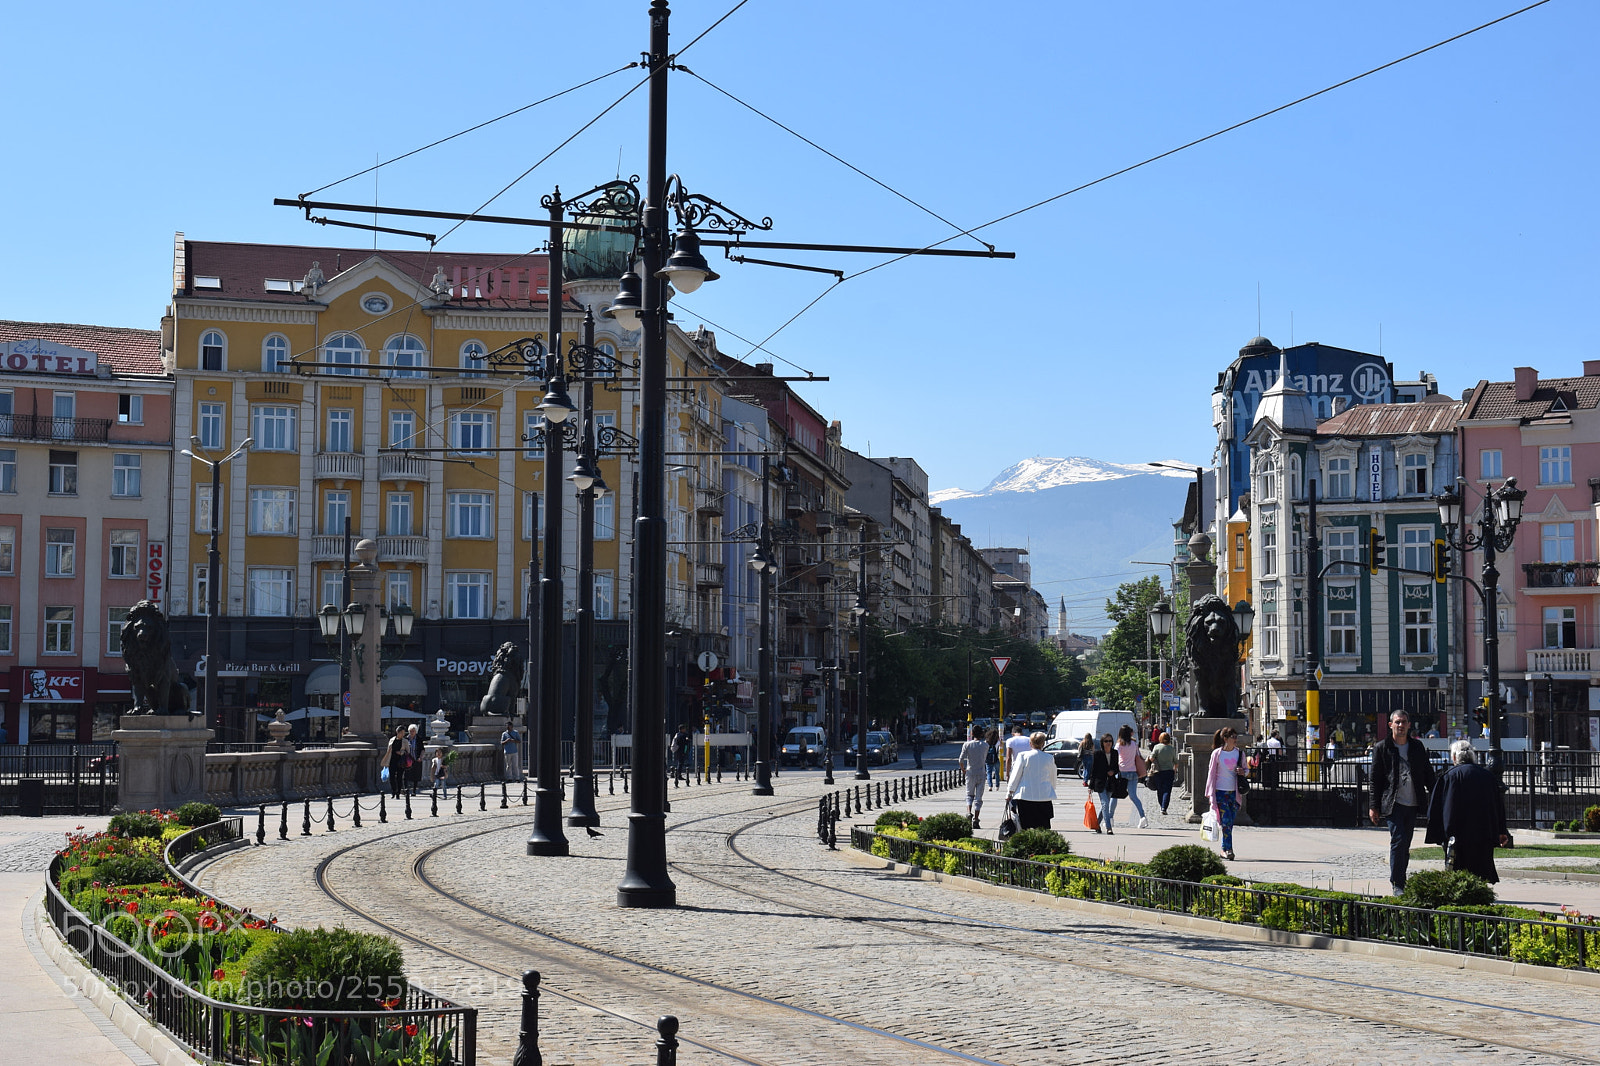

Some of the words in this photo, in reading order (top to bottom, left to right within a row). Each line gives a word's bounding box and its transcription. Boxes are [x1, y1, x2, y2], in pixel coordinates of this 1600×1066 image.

[453, 265, 570, 301] HOTE
[1371, 454, 1380, 501] HOTEL
[148, 544, 162, 603] HOST
[48, 676, 80, 687] KFC
[225, 663, 249, 672] Pizza
[251, 663, 268, 672] Bar
[269, 663, 276, 672] &
[278, 663, 300, 672] Grill
